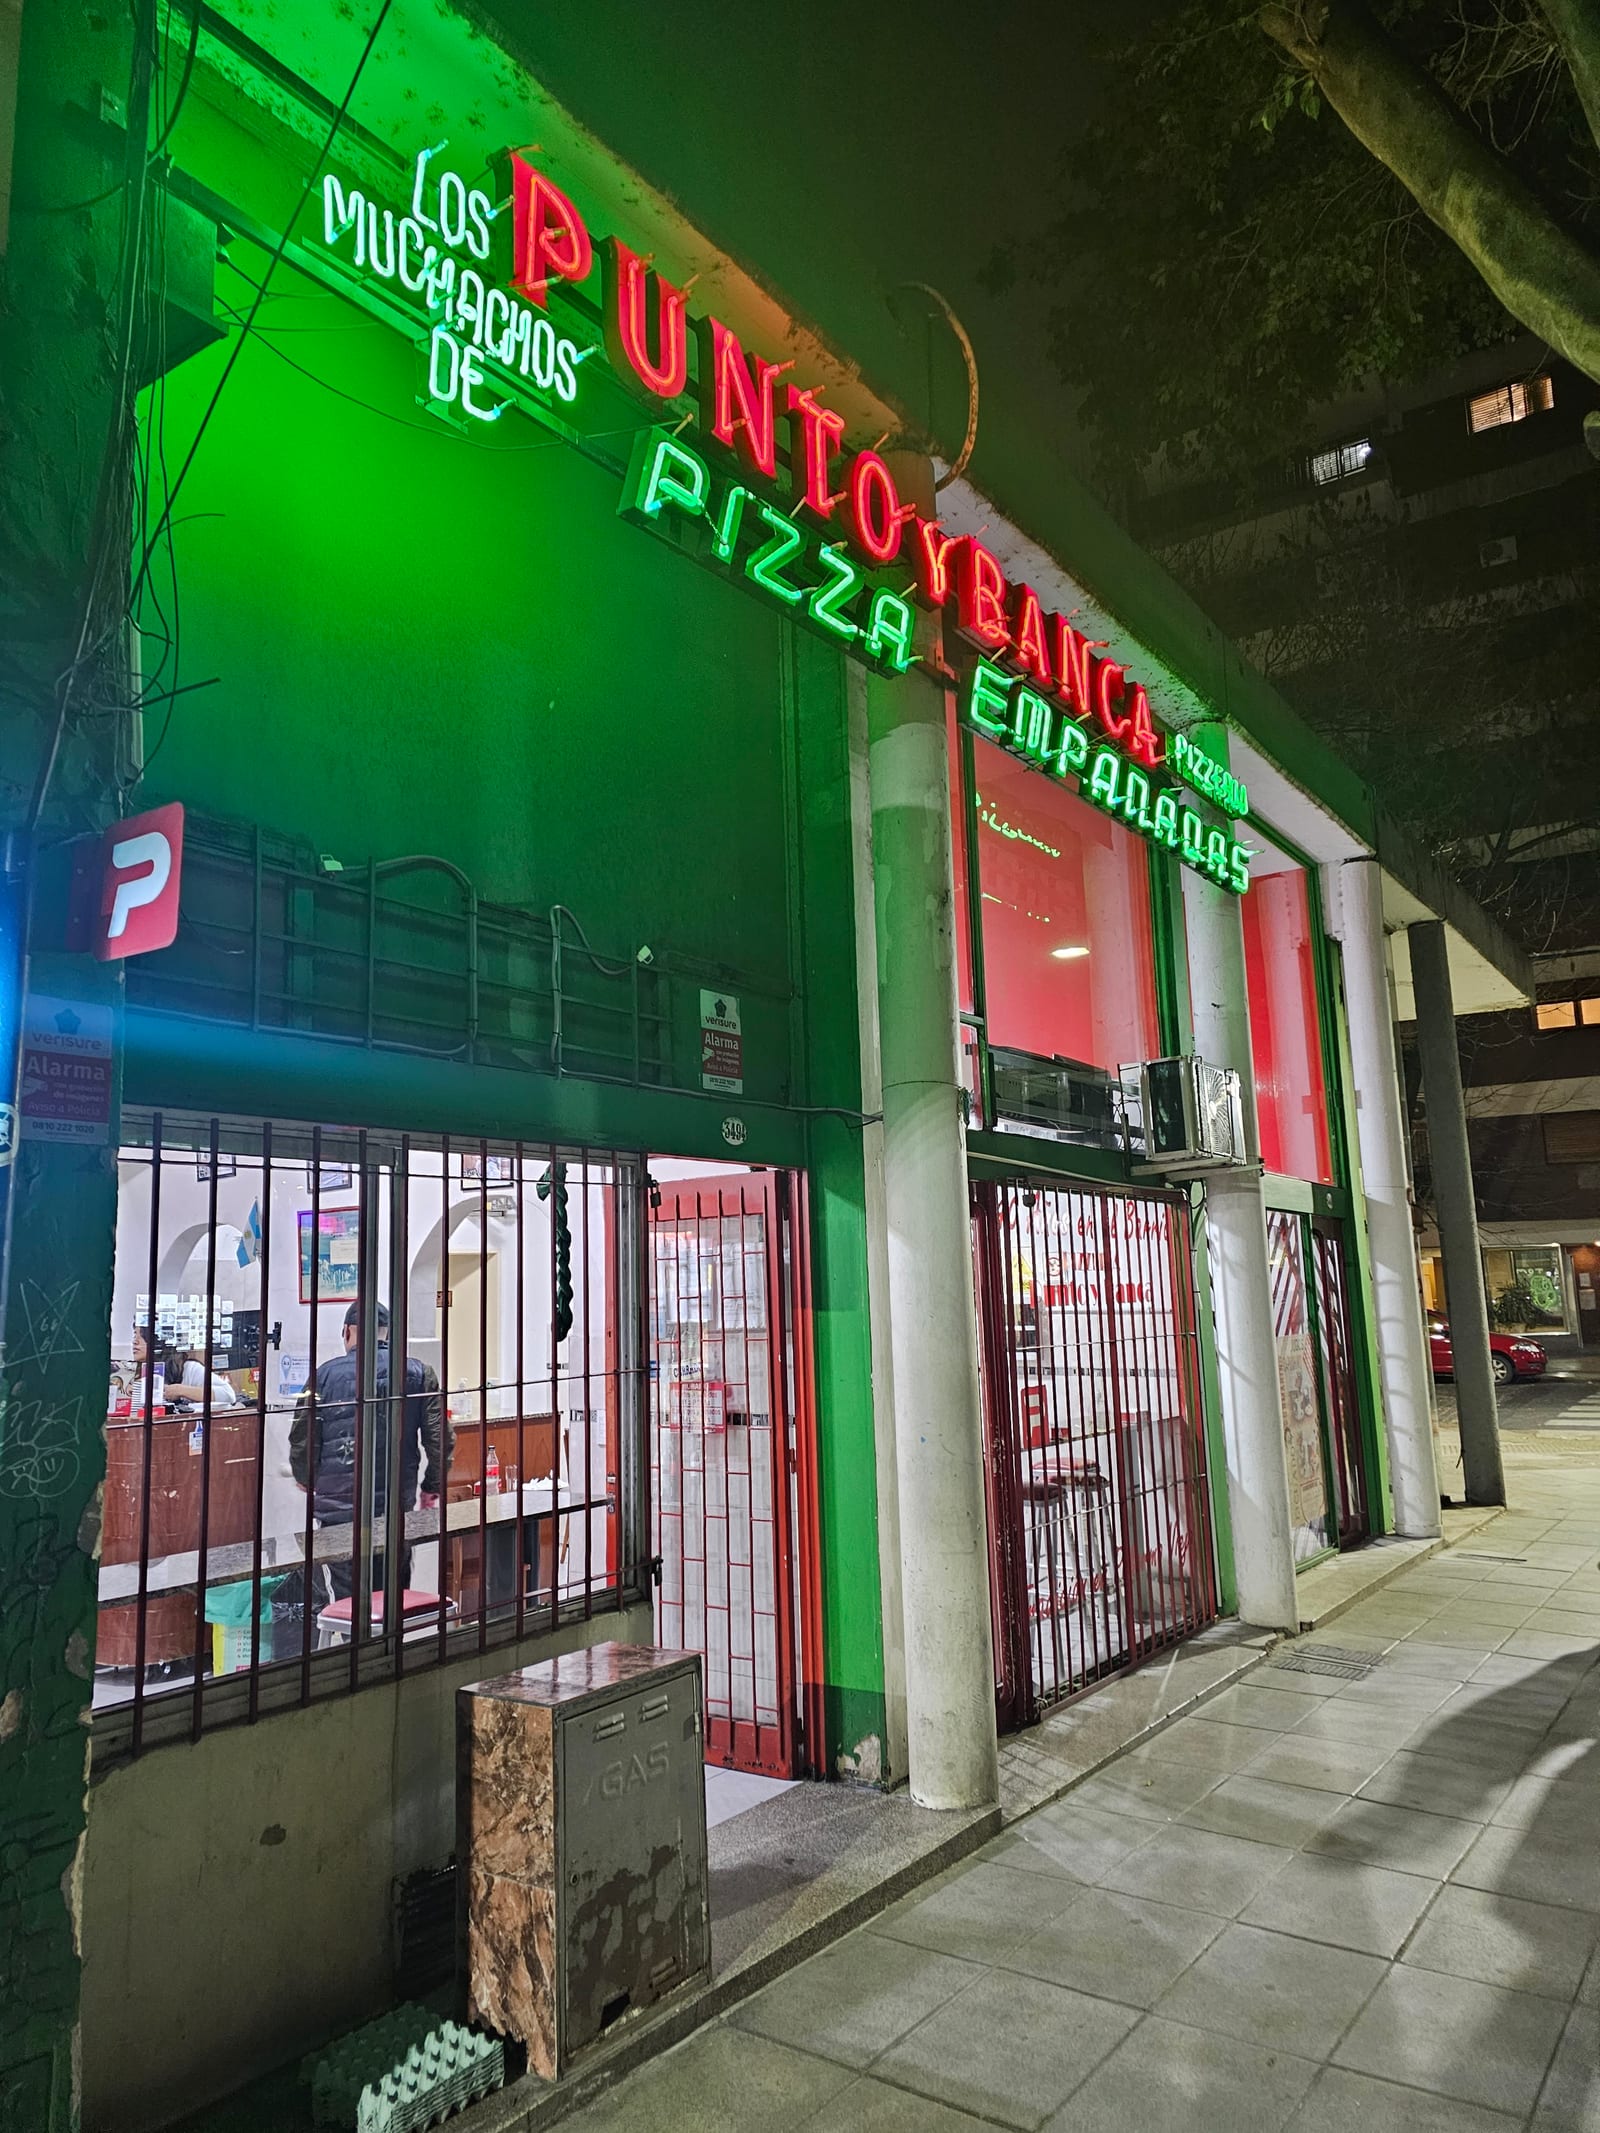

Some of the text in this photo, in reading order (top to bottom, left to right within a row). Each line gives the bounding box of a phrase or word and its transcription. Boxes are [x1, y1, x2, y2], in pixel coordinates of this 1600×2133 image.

[413, 148, 492, 259] LOS
[323, 174, 578, 401] MUCHACHOS
[428, 329, 499, 421] DE
[640, 425, 917, 674] PIZZA
[970, 656, 1250, 895] EMPANADAS
[32, 1033, 102, 1051] verisure
[704, 1032, 739, 1051] Alarma
[705, 1016, 737, 1030] verisure
[26, 1055, 105, 1081] Alarma
[602, 1741, 669, 1798] GAS
